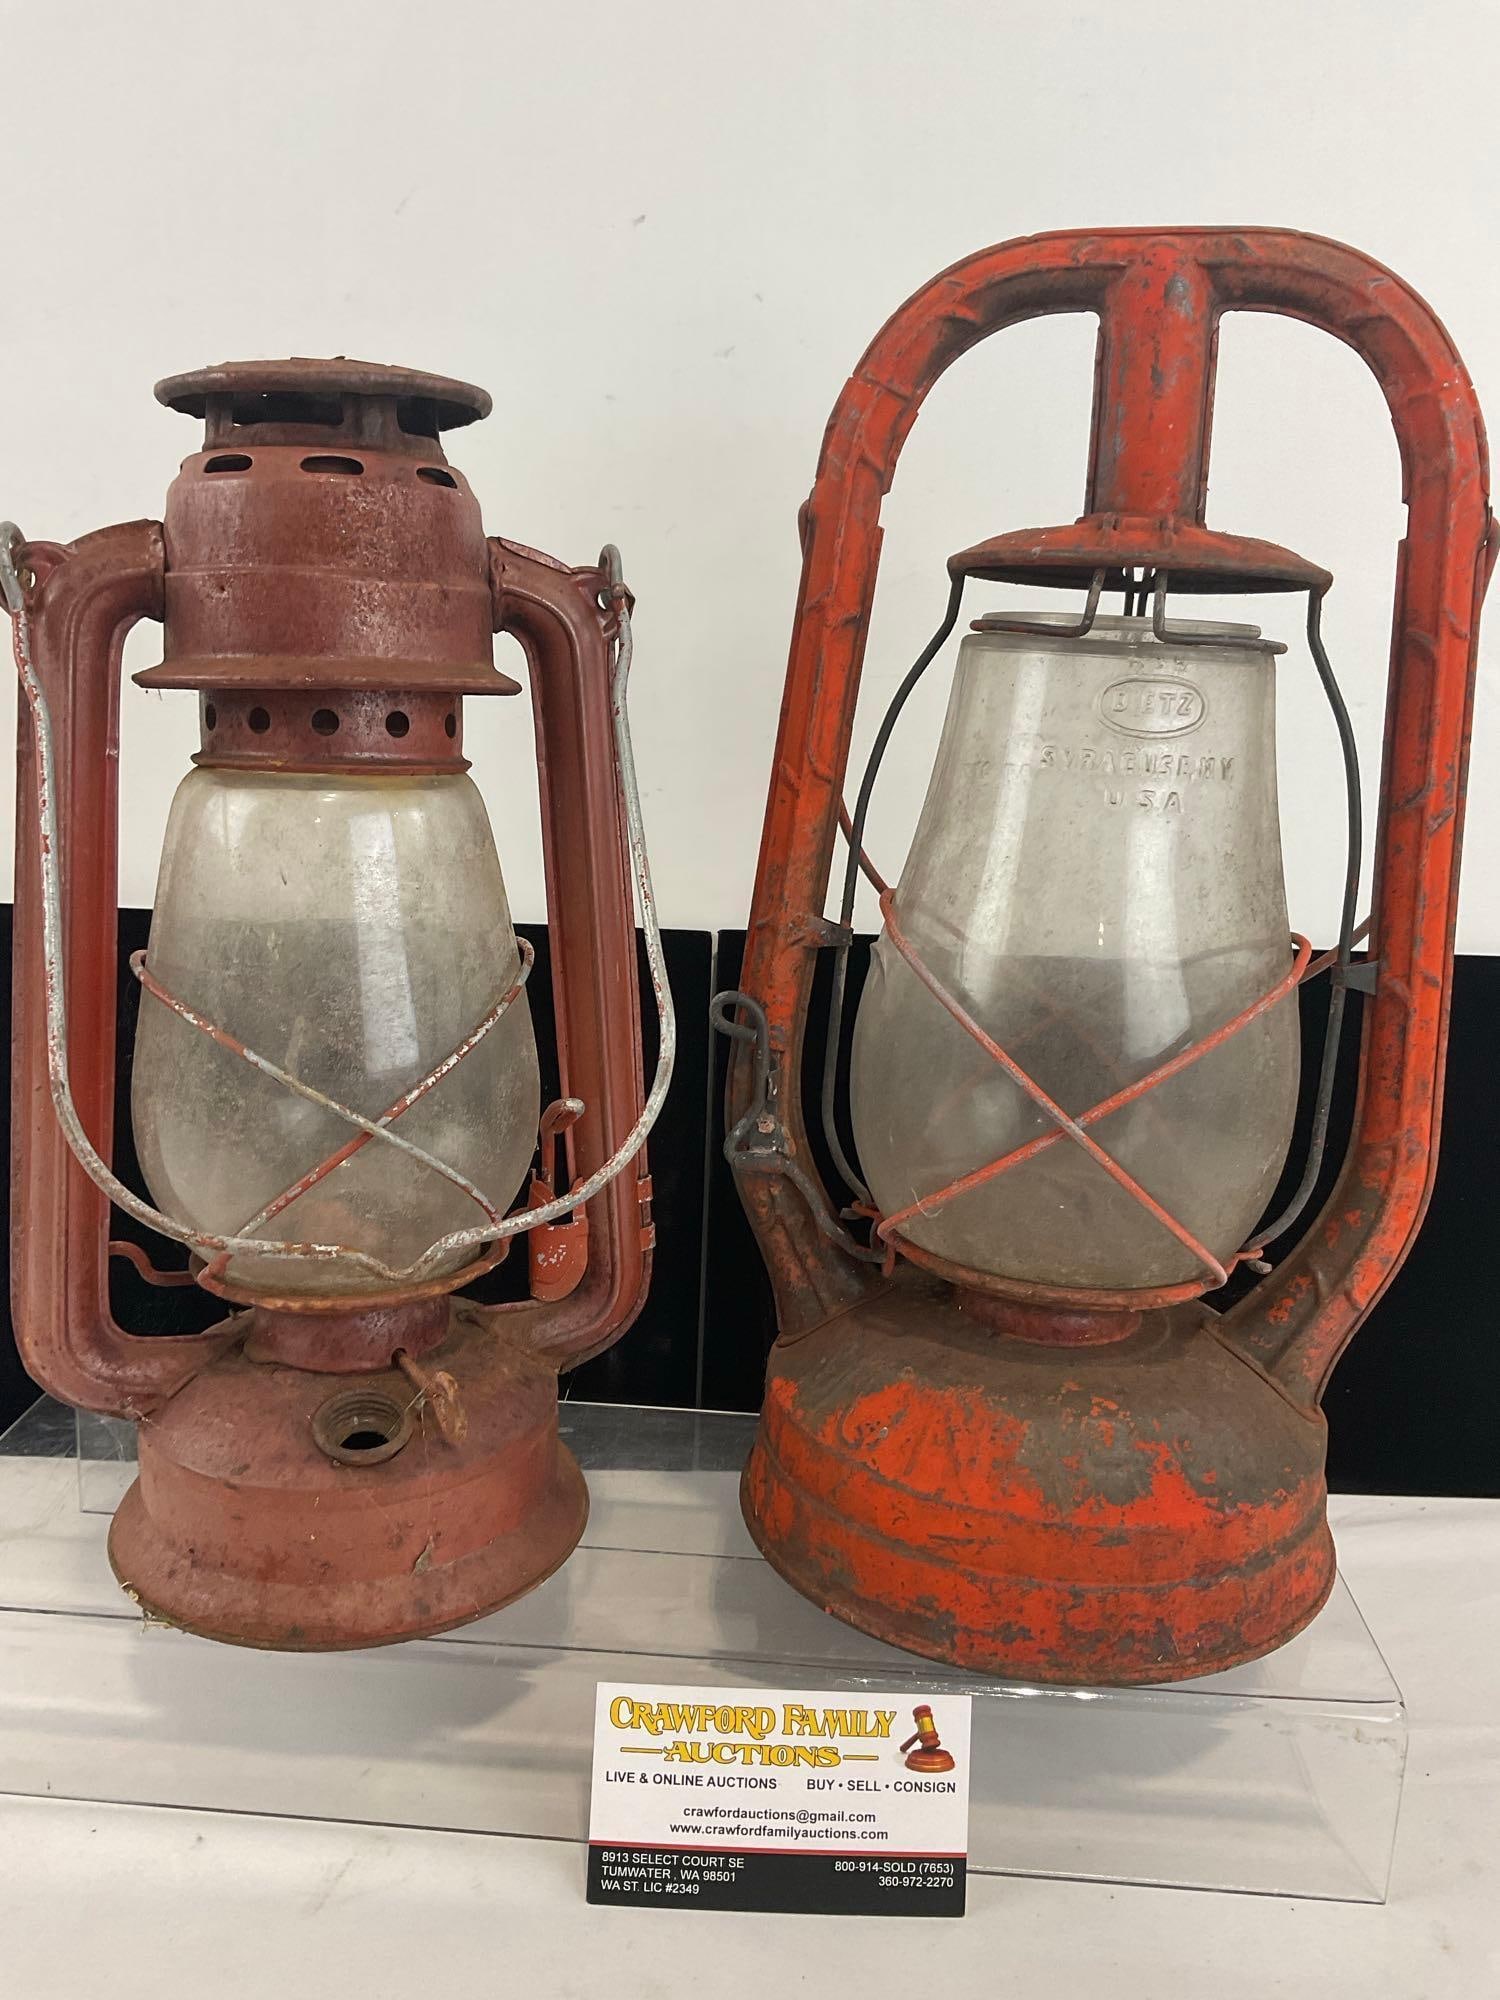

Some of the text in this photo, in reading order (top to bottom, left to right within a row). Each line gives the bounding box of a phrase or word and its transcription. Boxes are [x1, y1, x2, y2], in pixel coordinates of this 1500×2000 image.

[1111, 692, 1195, 716] DIETZ
[610, 1696, 897, 1740] CRAWFORD FAMILY
[663, 1741, 841, 1768] AUCTIONS
[606, 1771, 777, 1790] LIVE & ONLINE AUCTIONS
[806, 1778, 956, 1794] BUY SELL CONSIGN
[683, 1806, 876, 1823] crawfordauctions@gmail.com
[669, 1824, 889, 1840] www.crawfordfamilyauctions.com
[602, 1851, 745, 1869] 8913 SELECT COURT SE
[602, 1866, 671, 1879] TUMWATER
[681, 1870, 700, 1881] WA
[703, 1871, 736, 1882] 98501
[834, 1861, 955, 1876] 800-914-SOLD (7653)
[601, 1880, 620, 1891] WA
[644, 1882, 662, 1893] LIC
[665, 1883, 700, 1895] #2349
[878, 1876, 954, 1888] 360-972-2270
